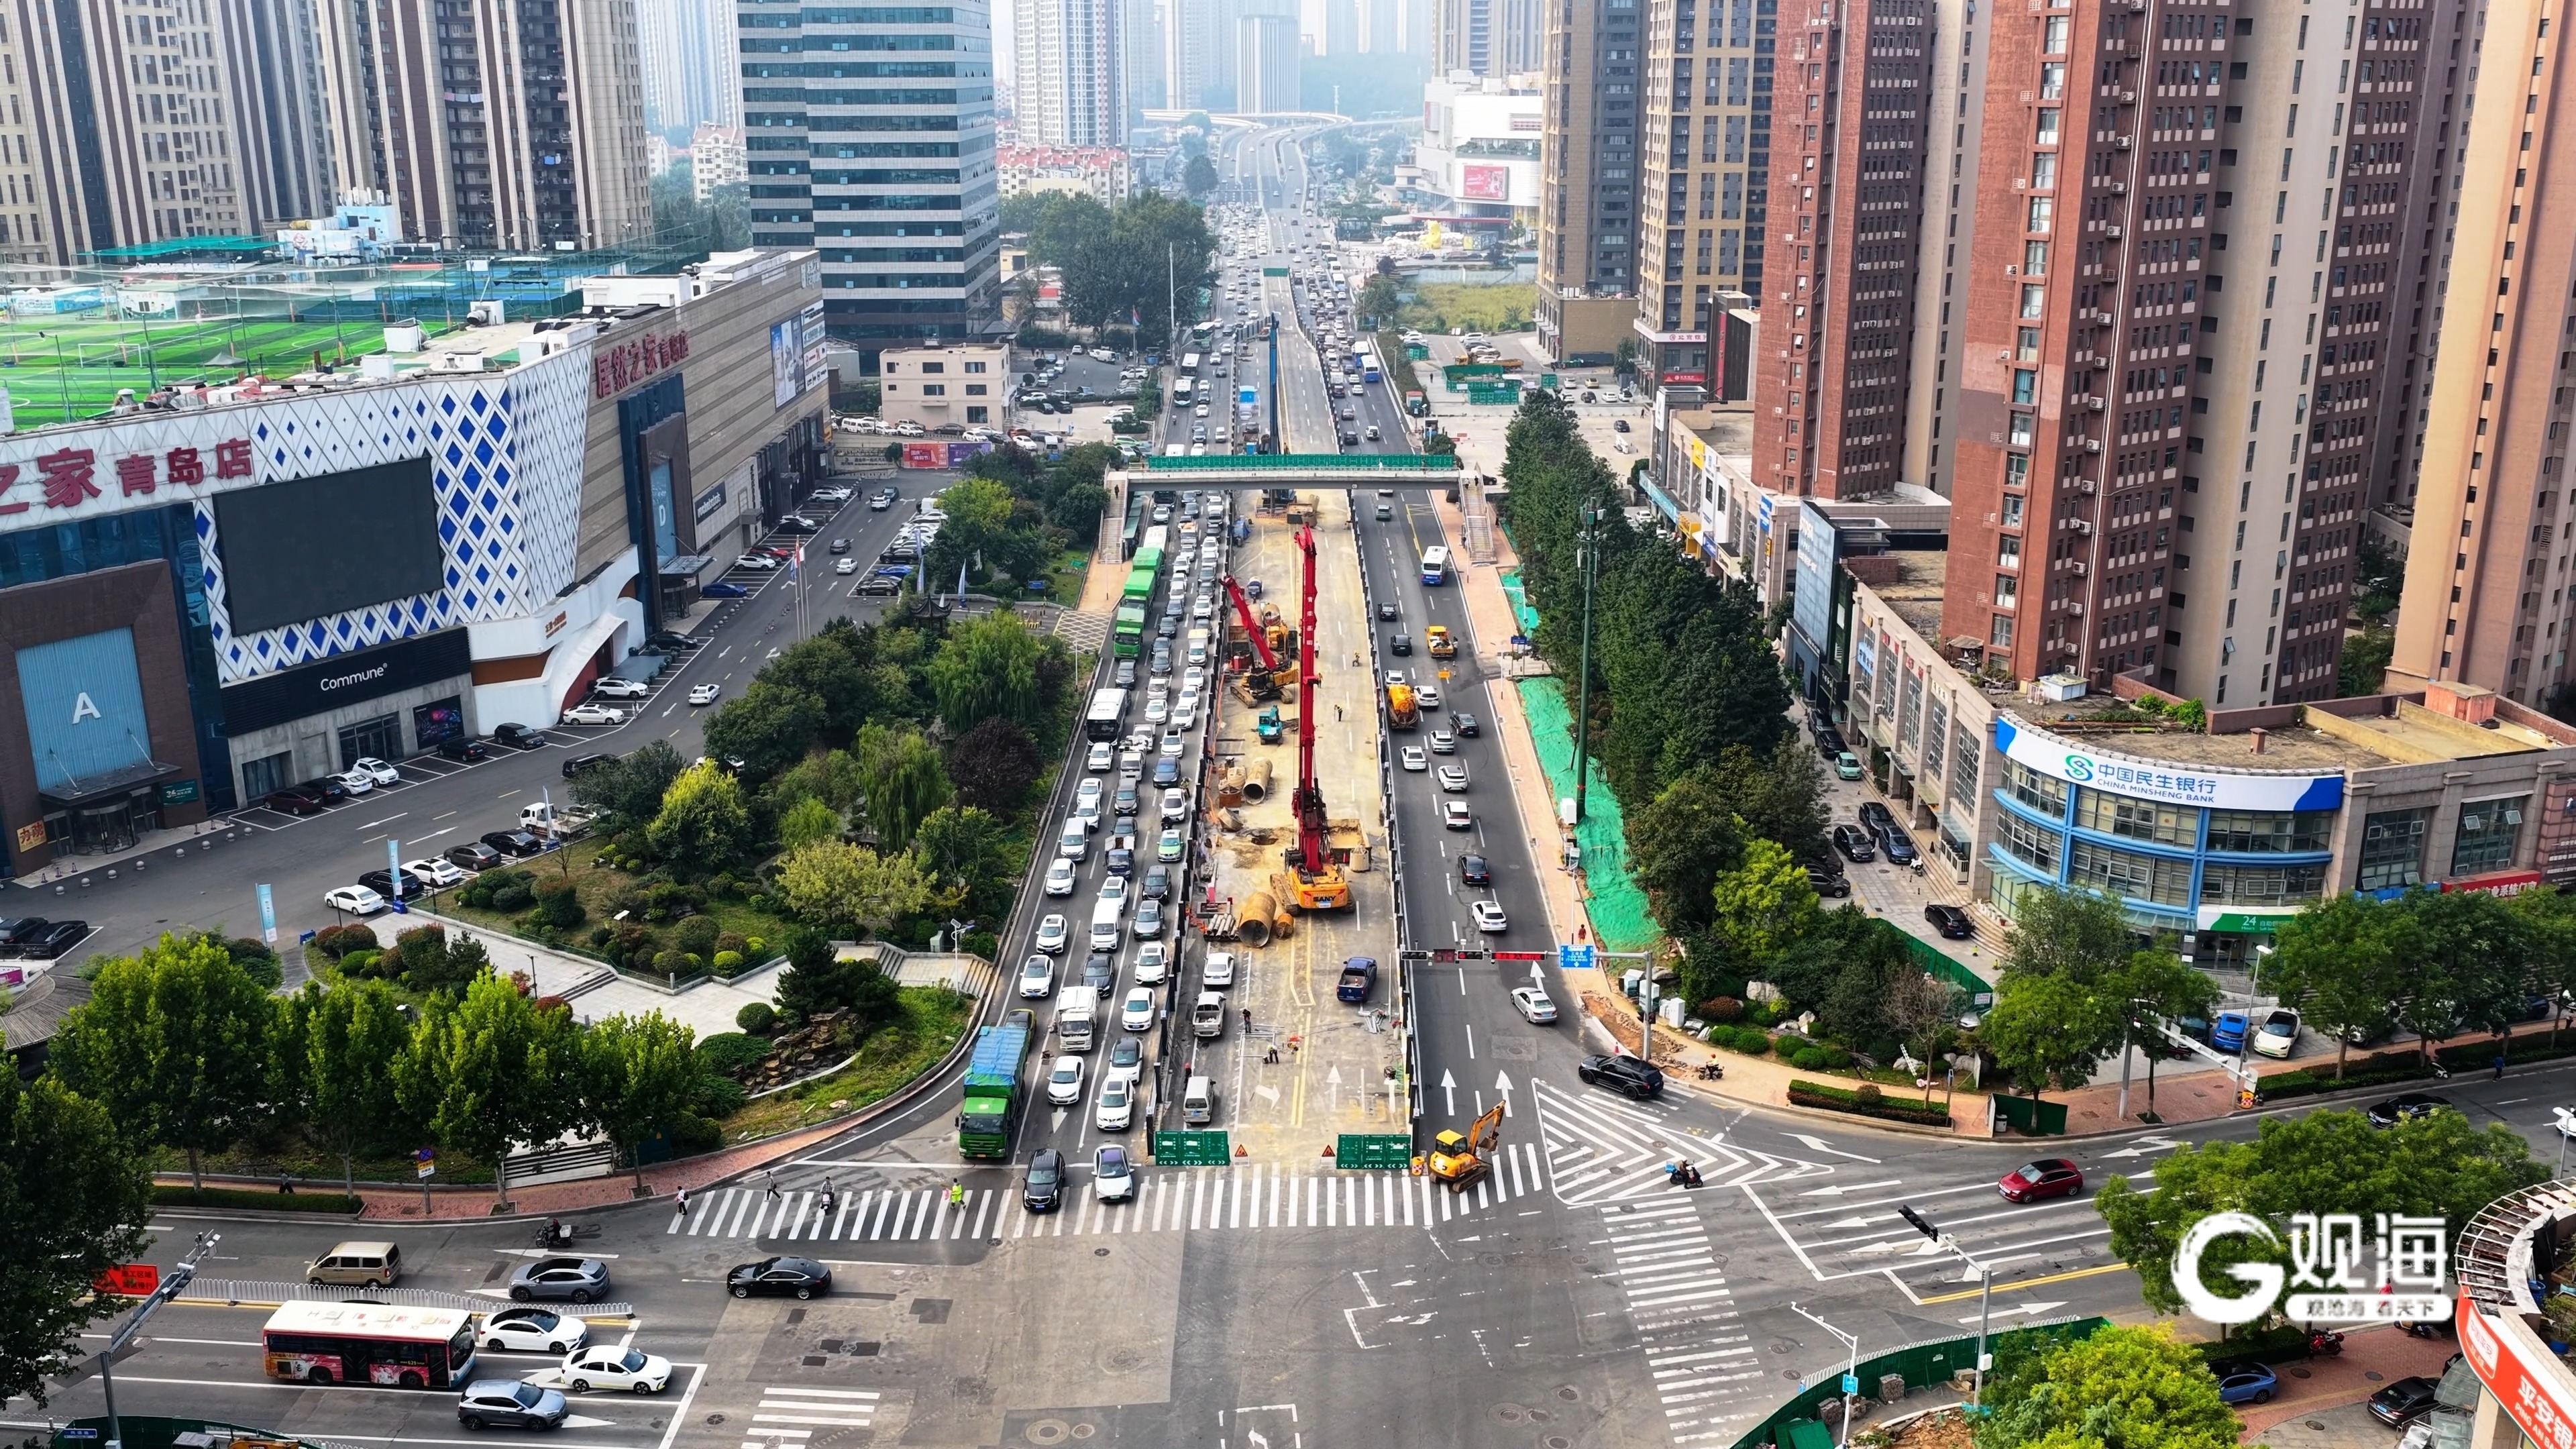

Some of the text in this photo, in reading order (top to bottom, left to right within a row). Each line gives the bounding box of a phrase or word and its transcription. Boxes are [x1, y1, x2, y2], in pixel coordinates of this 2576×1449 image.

[659, 504, 667, 527] D
[72, 691, 101, 724] A
[2098, 763, 2216, 794] 中国民生银行
[2098, 778, 2214, 803] CHINA MINSHENG BANK
[2243, 916, 2257, 926] 24
[2515, 1402, 2532, 1426] PING
[2532, 1426, 2544, 1440] AN
[2518, 1374, 2576, 1449] 平安银
